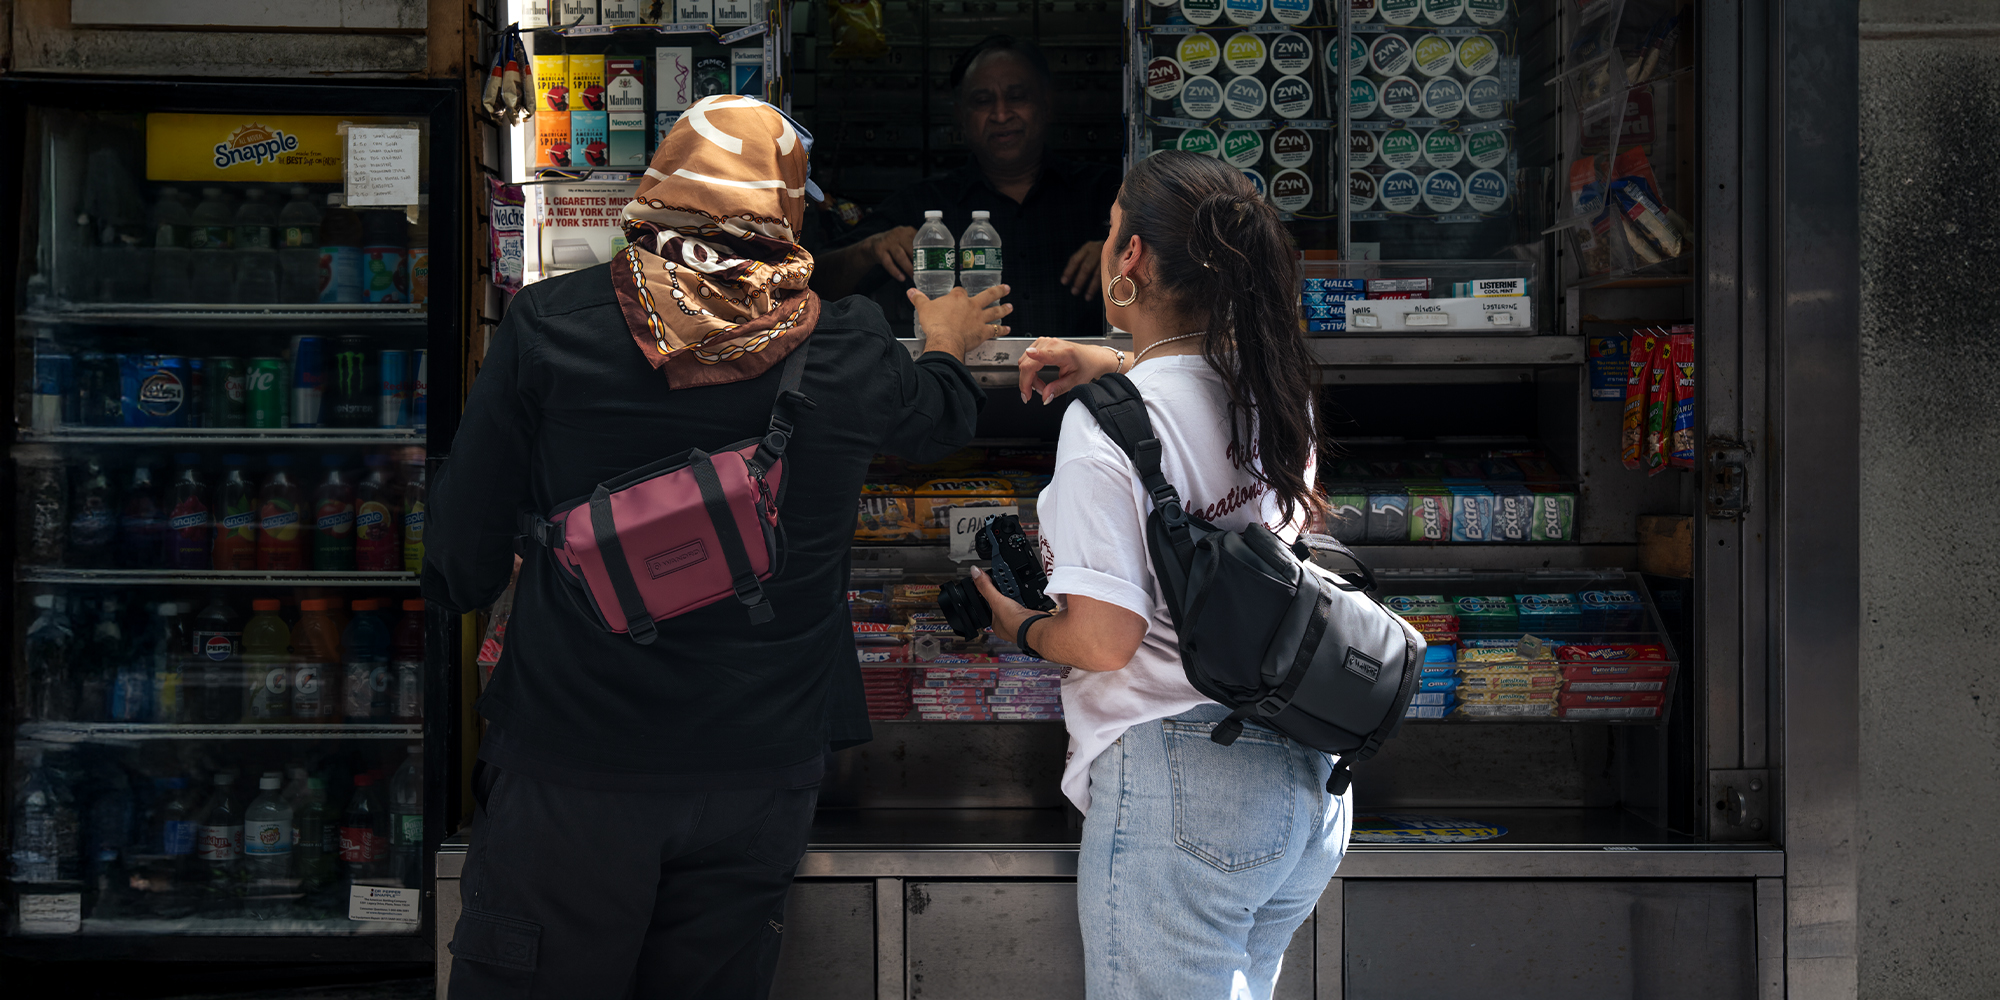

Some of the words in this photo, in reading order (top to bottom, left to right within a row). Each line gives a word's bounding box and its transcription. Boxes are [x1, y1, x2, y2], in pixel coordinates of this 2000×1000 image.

[605, 4, 636, 18] Marlboro
[681, 4, 708, 19] Marlboro
[719, 4, 748, 19] Marlboro
[1184, 41, 1210, 54] ZYN
[1231, 41, 1257, 53] ZYN
[1278, 42, 1304, 53] ZYN
[1375, 40, 1400, 62] ZYN
[1418, 40, 1444, 58] ZYN
[1461, 40, 1485, 59] ZYN
[697, 58, 726, 69] CAMEL
[888, 52, 902, 64] 19
[1061, 54, 1068, 64] 4
[1114, 54, 1121, 65] 3
[1149, 65, 1174, 79] ZYN
[574, 81, 600, 89] SPIRIT
[1189, 86, 1214, 96] ZYN
[1233, 84, 1259, 98] ZYN
[1277, 85, 1303, 98] ZYN
[609, 90, 642, 106] Marlboro
[1388, 86, 1413, 98] ZYN
[1430, 86, 1456, 100] ZYN
[1473, 86, 1499, 99] ZYN
[576, 137, 603, 145] SPIRIT
[1185, 134, 1211, 148] ZYN
[1227, 133, 1253, 150] ZYN
[1278, 136, 1304, 147] ZYN
[1386, 135, 1412, 147] ZYN
[1430, 135, 1455, 147] ZYN
[1471, 133, 1497, 148] ZYN
[214, 132, 299, 168] Snapple
[286, 156, 302, 165] BEST
[1278, 179, 1303, 190] ZYN
[1387, 180, 1413, 191] ZYN
[1431, 179, 1457, 190] ZYN
[1474, 178, 1500, 190] ZYN
[553, 197, 606, 206] CIGARETTES
[609, 197, 633, 206] MUST
[494, 208, 524, 226] Welch's
[548, 208, 554, 216] A
[557, 208, 577, 216] NEW
[580, 208, 604, 216] YORK
[556, 219, 580, 227] YORK
[582, 219, 608, 227] STATE
[505, 240, 518, 249] Fruit
[502, 247, 521, 258] Snacks
[1480, 281, 1517, 289] LISTERINE
[246, 367, 274, 391] ite
[383, 381, 402, 390] Red
[225, 381, 245, 391] CAN
[1372, 504, 1404, 516] 5
[172, 512, 207, 529] snapple
[262, 512, 298, 529] snapple
[957, 517, 984, 534] CAN
[1423, 498, 1441, 540] Extra
[1464, 498, 1483, 540] Extra
[1504, 498, 1521, 540] Extra
[1544, 498, 1562, 540] Extra
[663, 549, 700, 566] WANDRD
[1390, 597, 1439, 612] Orbit
[1459, 597, 1509, 612] Orbit
[1521, 595, 1571, 611] Orbit
[1584, 592, 1633, 607] Orbit
[852, 622, 890, 632] YDAY
[858, 651, 890, 662] lers
[1589, 648, 1612, 658] Nutter
[1604, 650, 1625, 659] Butter
[266, 668, 287, 694] G
[295, 668, 318, 694] G
